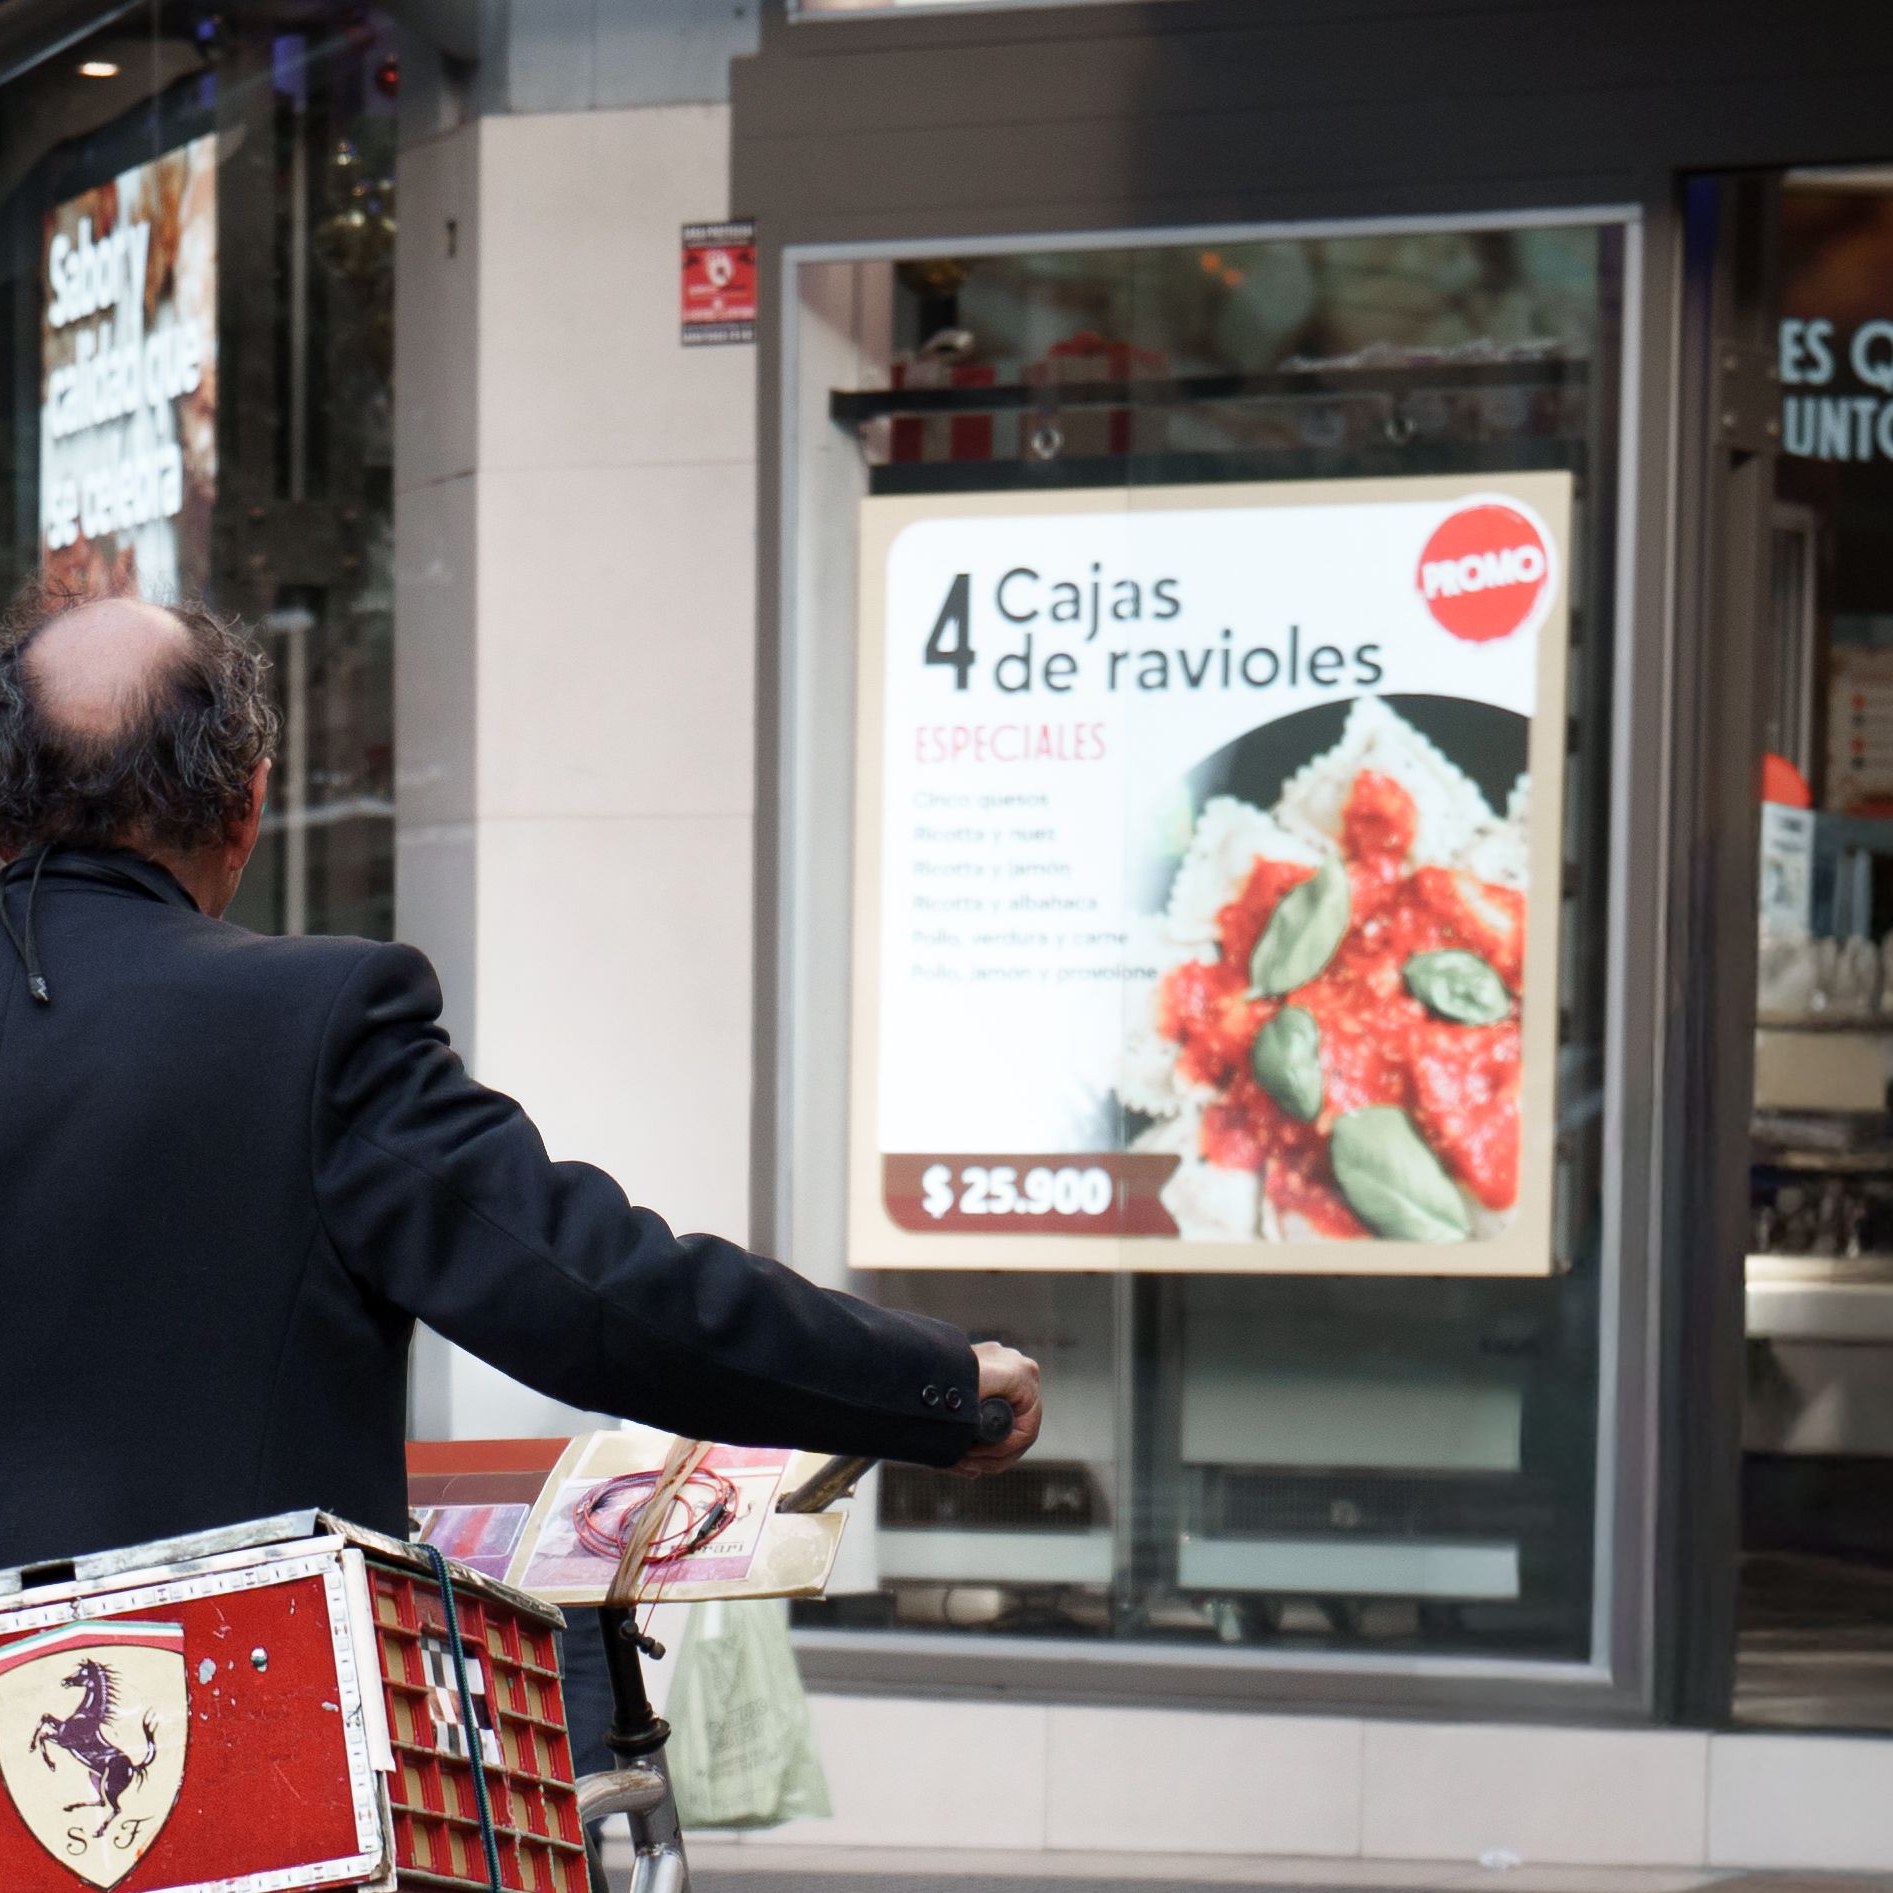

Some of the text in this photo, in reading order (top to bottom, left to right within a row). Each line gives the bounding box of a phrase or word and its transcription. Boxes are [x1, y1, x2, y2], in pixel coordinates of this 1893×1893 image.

[1423, 545, 1546, 600] PROMO
[923, 562, 1181, 690] 4 Cajas
[993, 625, 1384, 692] de ravioles
[915, 722, 1107, 764] ESPECIALES
[979, 792, 1049, 811] quesos
[913, 825, 1056, 845] Ricotta y nuez
[913, 859, 984, 876] Ricotta
[992, 864, 1002, 880] y
[912, 893, 1098, 914] Ricotta y albahaca
[972, 929, 1049, 945] verdura
[1057, 963, 1158, 984] provolone
[922, 1164, 1113, 1219] $ 25.900
[67, 1815, 156, 1856] S F
